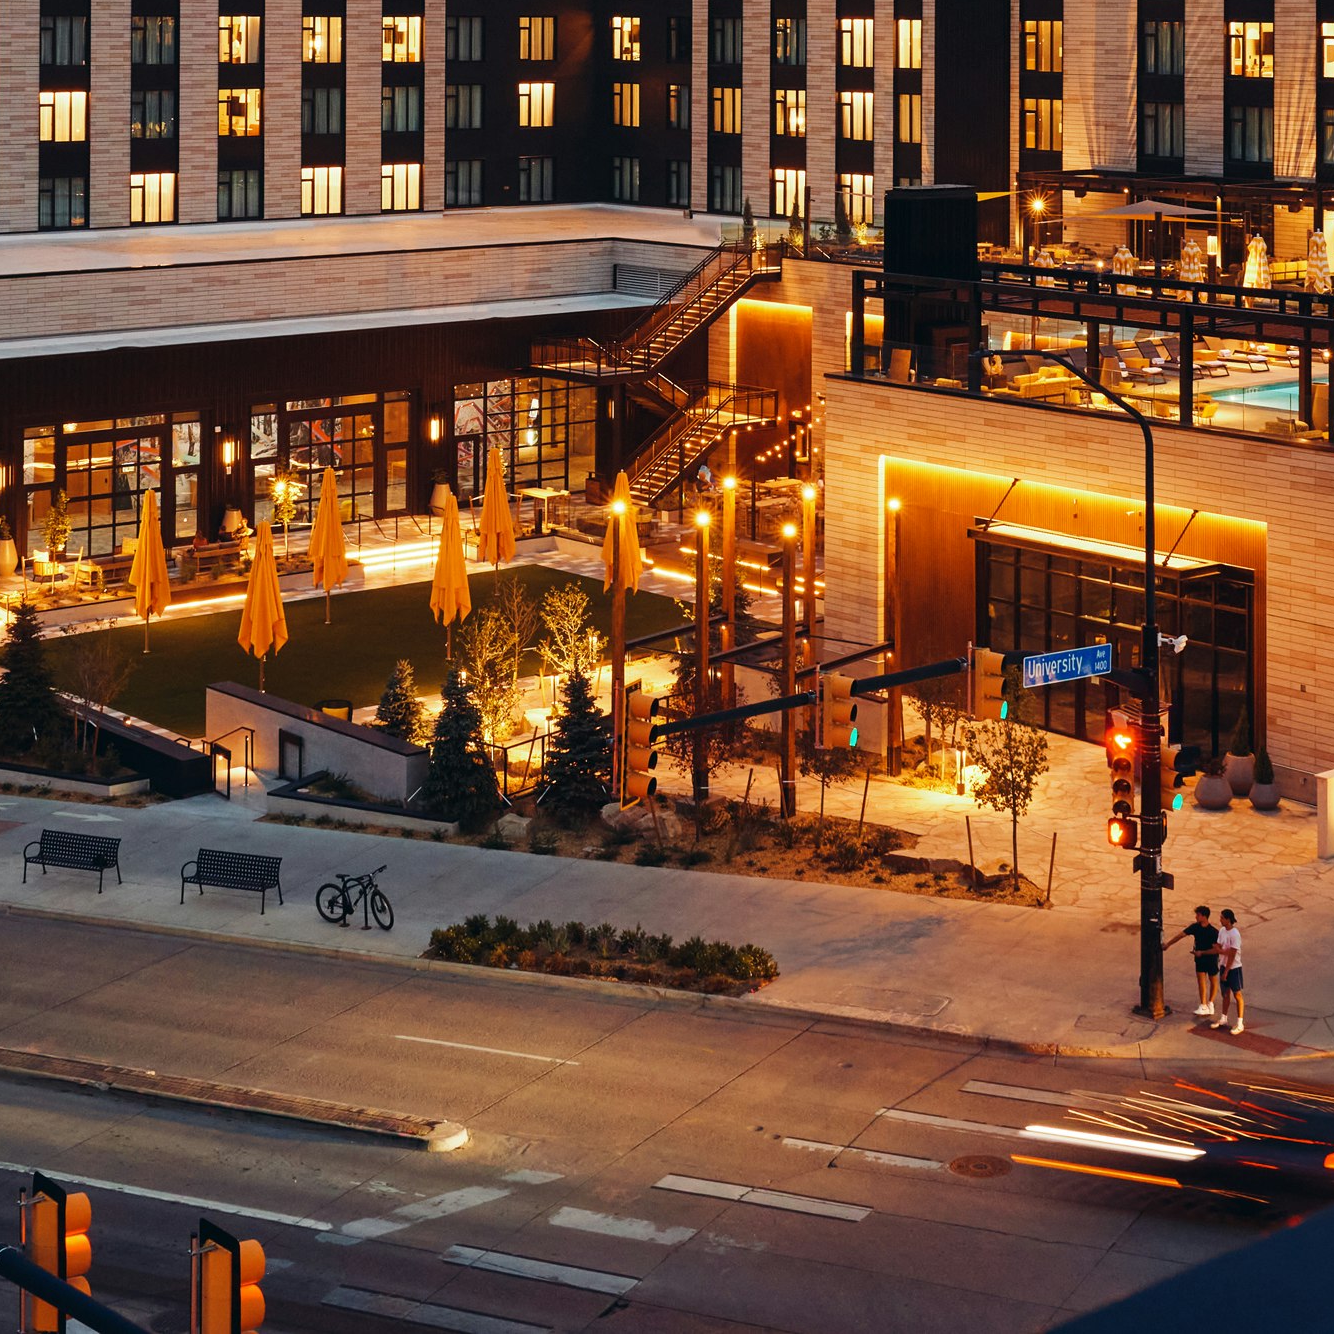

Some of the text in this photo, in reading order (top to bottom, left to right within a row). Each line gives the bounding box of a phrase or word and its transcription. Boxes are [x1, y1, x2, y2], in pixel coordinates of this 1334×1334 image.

[1028, 649, 1106, 679] University Ave
[1094, 660, 1108, 671] 1400
